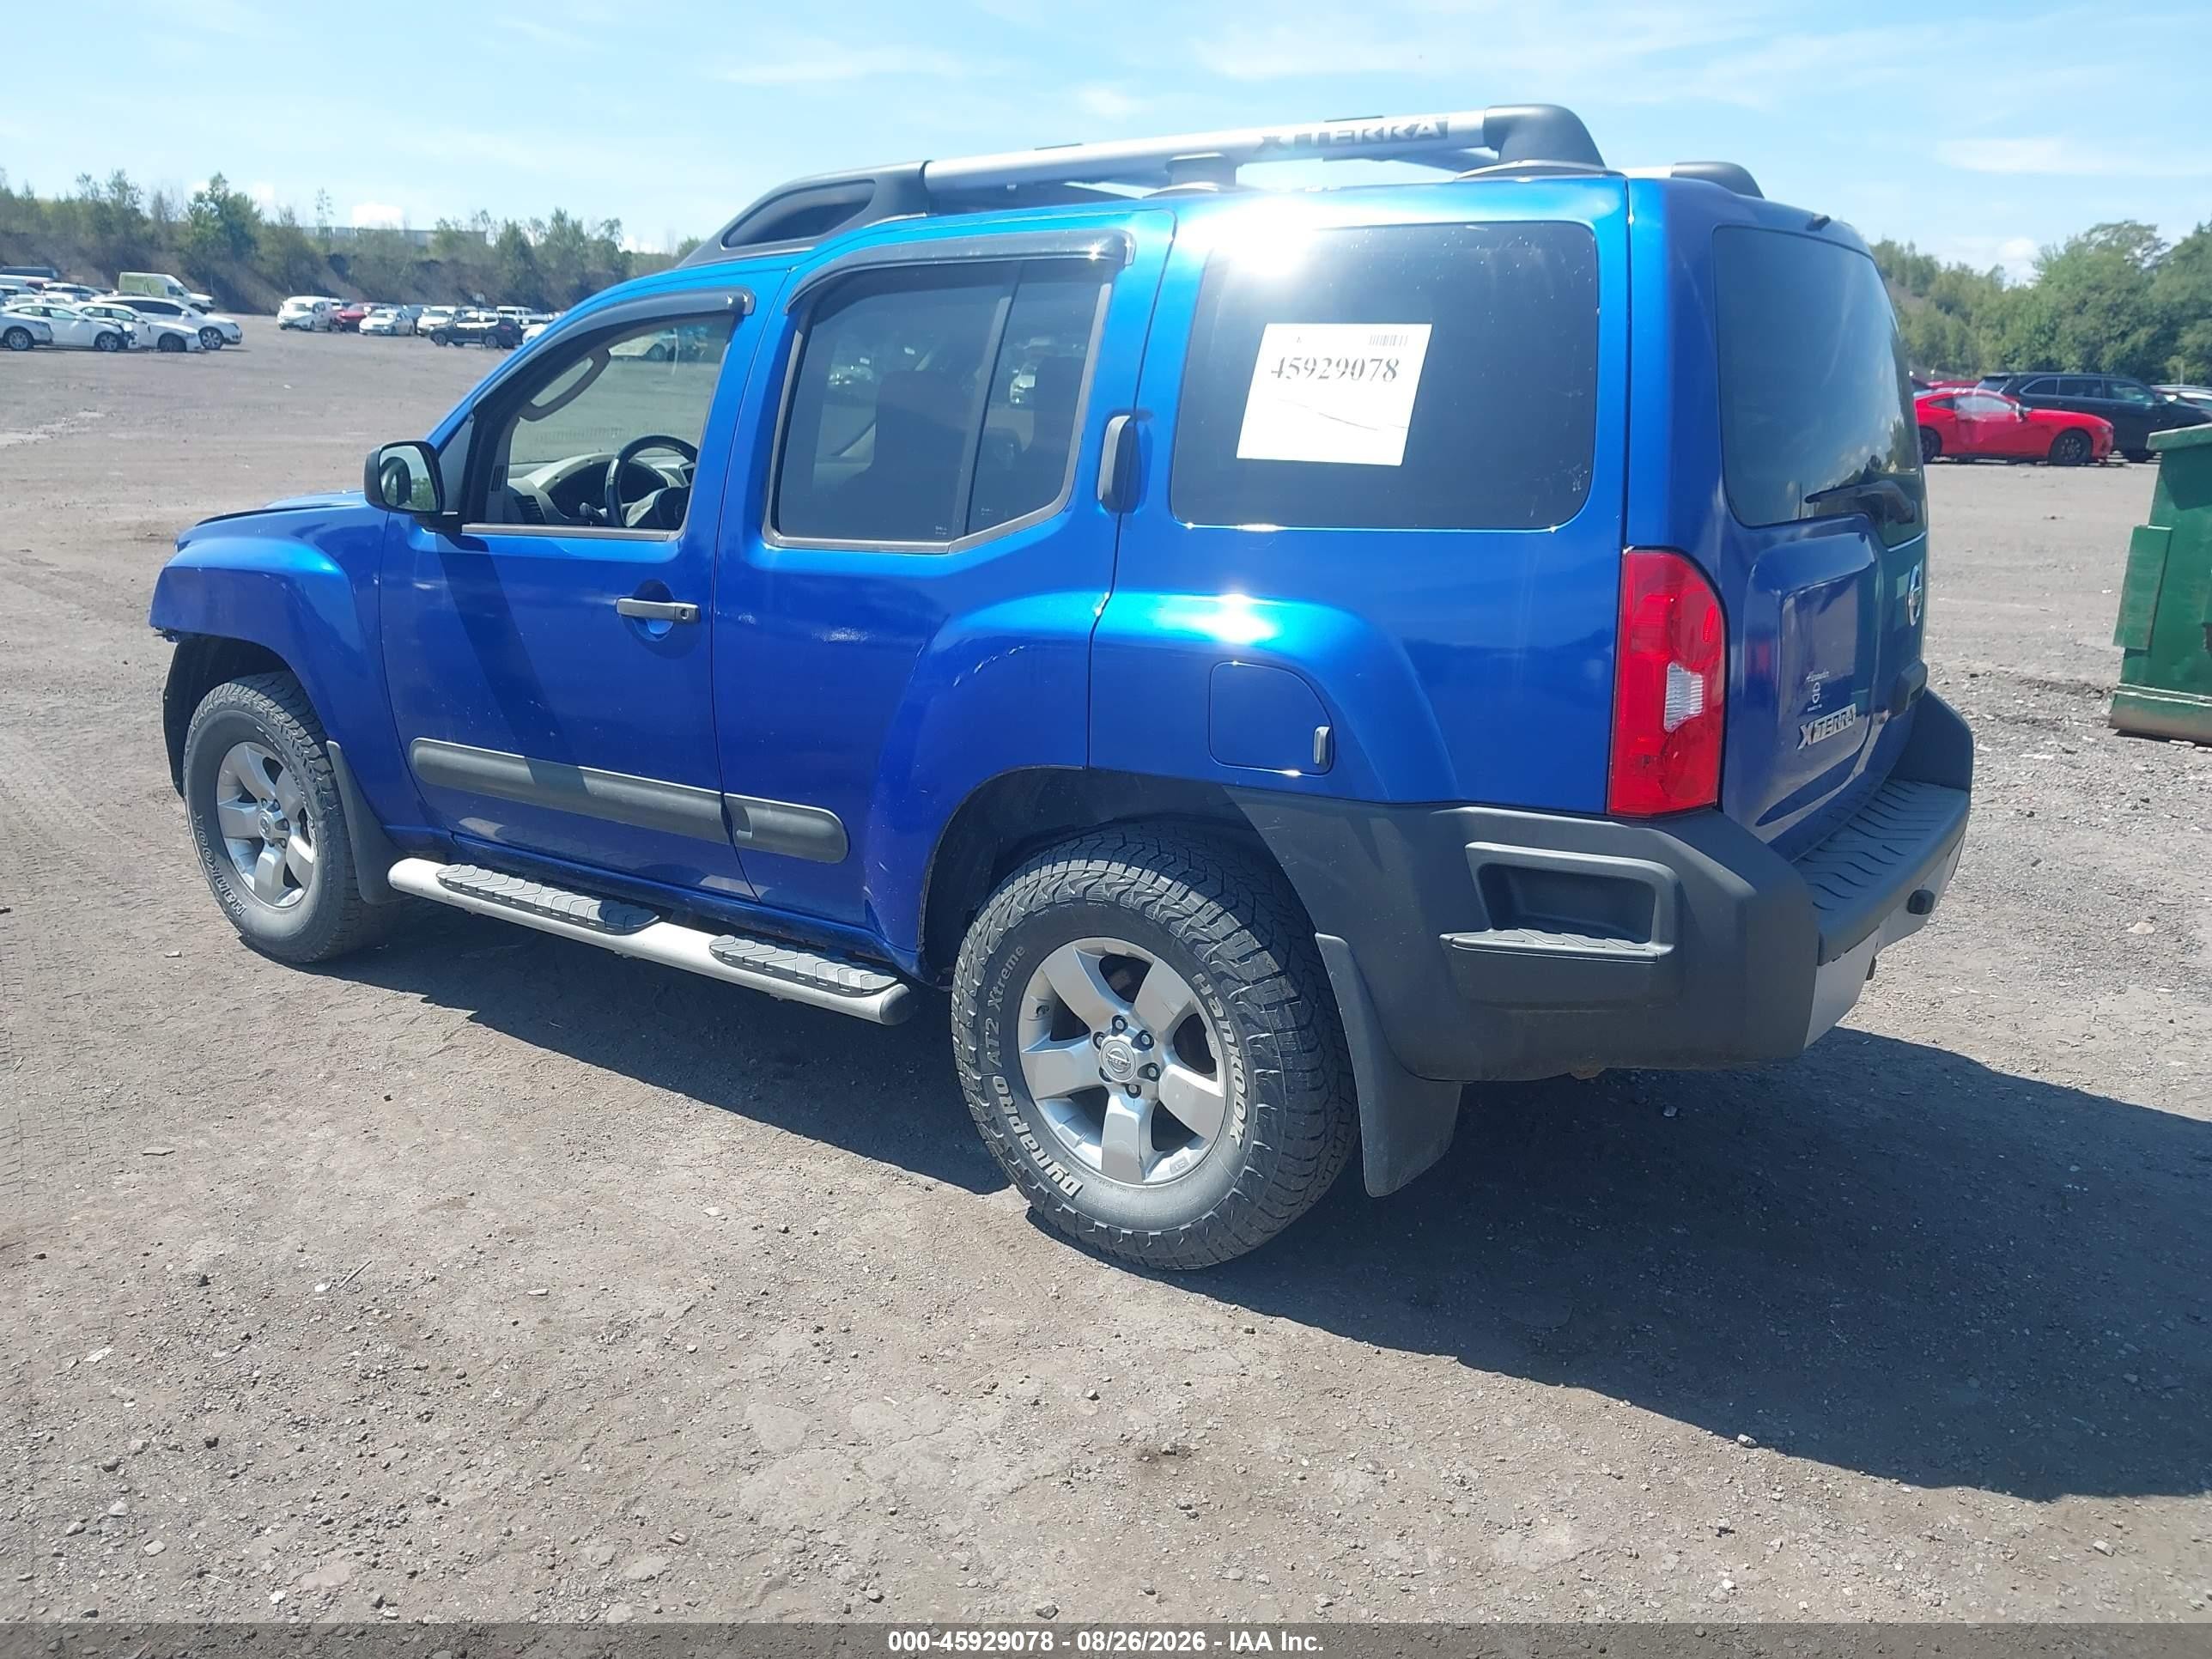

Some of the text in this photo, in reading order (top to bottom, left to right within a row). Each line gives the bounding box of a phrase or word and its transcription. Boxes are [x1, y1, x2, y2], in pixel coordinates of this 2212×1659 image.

[1271, 356, 1400, 383] 45929078
[1796, 703, 1856, 750] XTERRA
[986, 945, 1027, 1012] Xtreme
[984, 1016, 1004, 1068] AT2
